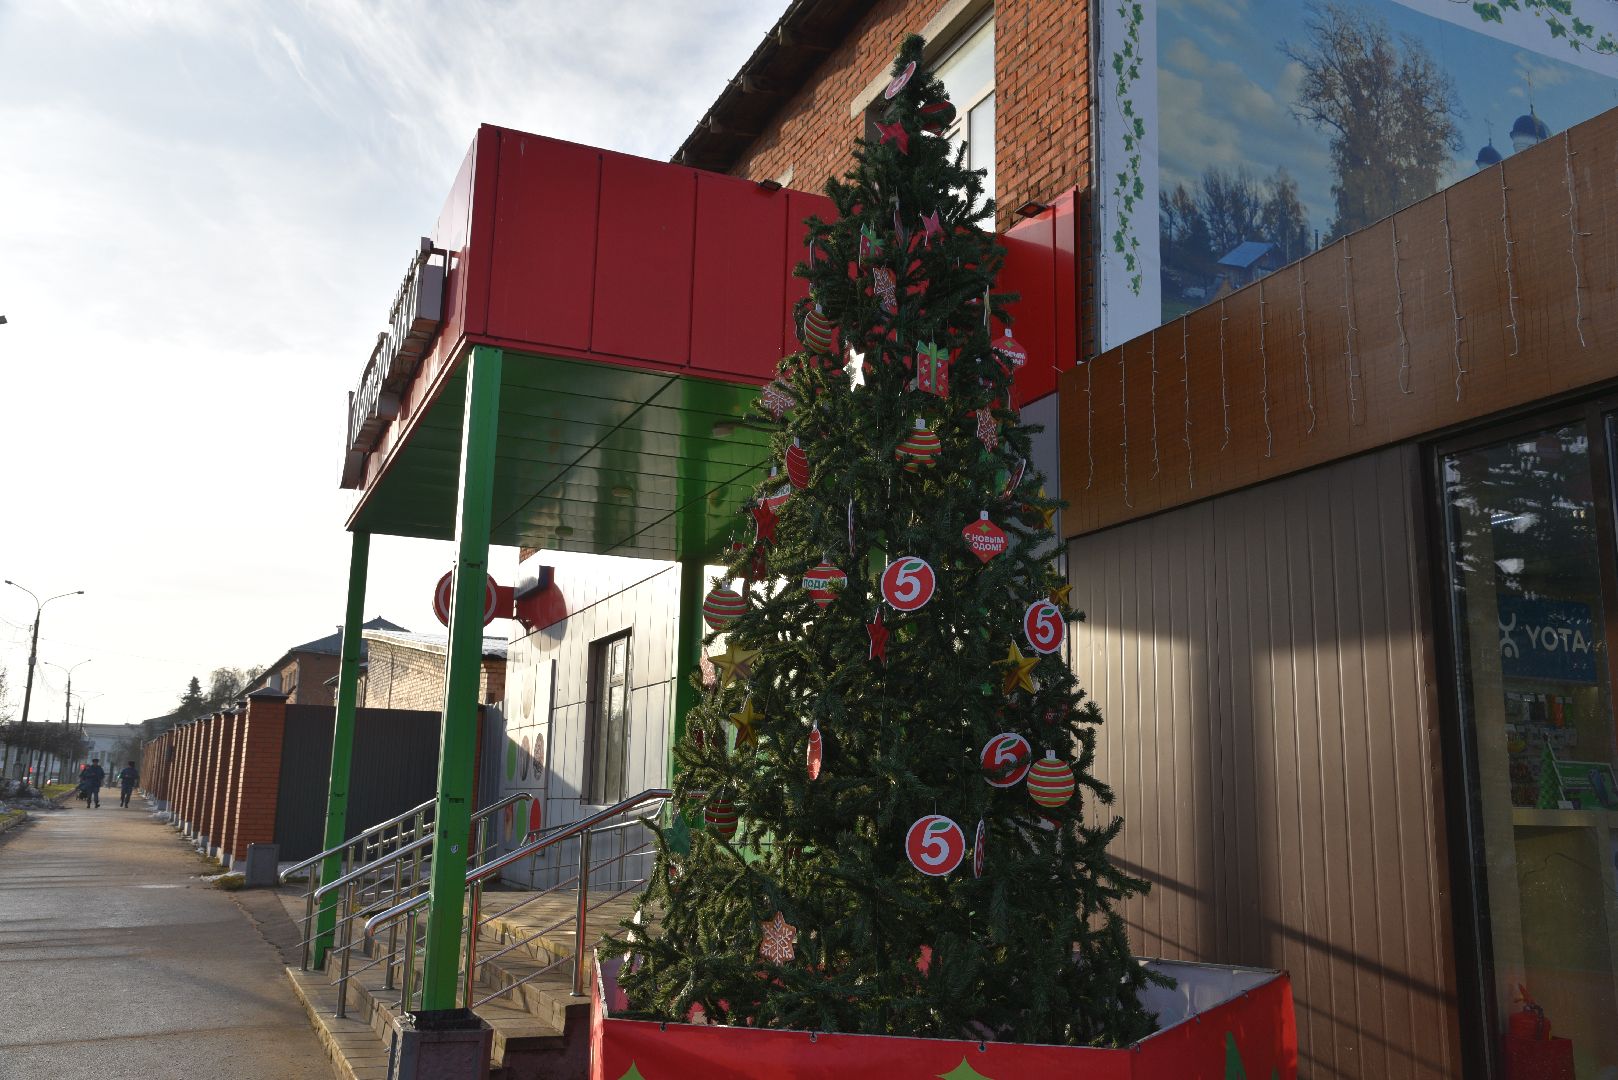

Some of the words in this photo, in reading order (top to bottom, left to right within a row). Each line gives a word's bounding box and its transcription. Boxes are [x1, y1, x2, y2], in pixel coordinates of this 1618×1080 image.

[969, 541, 1002, 552] ОДОМ!
[972, 533, 1004, 544] НОВЫМ
[803, 578, 846, 590] ПОДА
[894, 560, 924, 602] 5
[1035, 606, 1056, 644] 5
[1525, 624, 1588, 654] YOTA
[921, 820, 953, 866] 5
